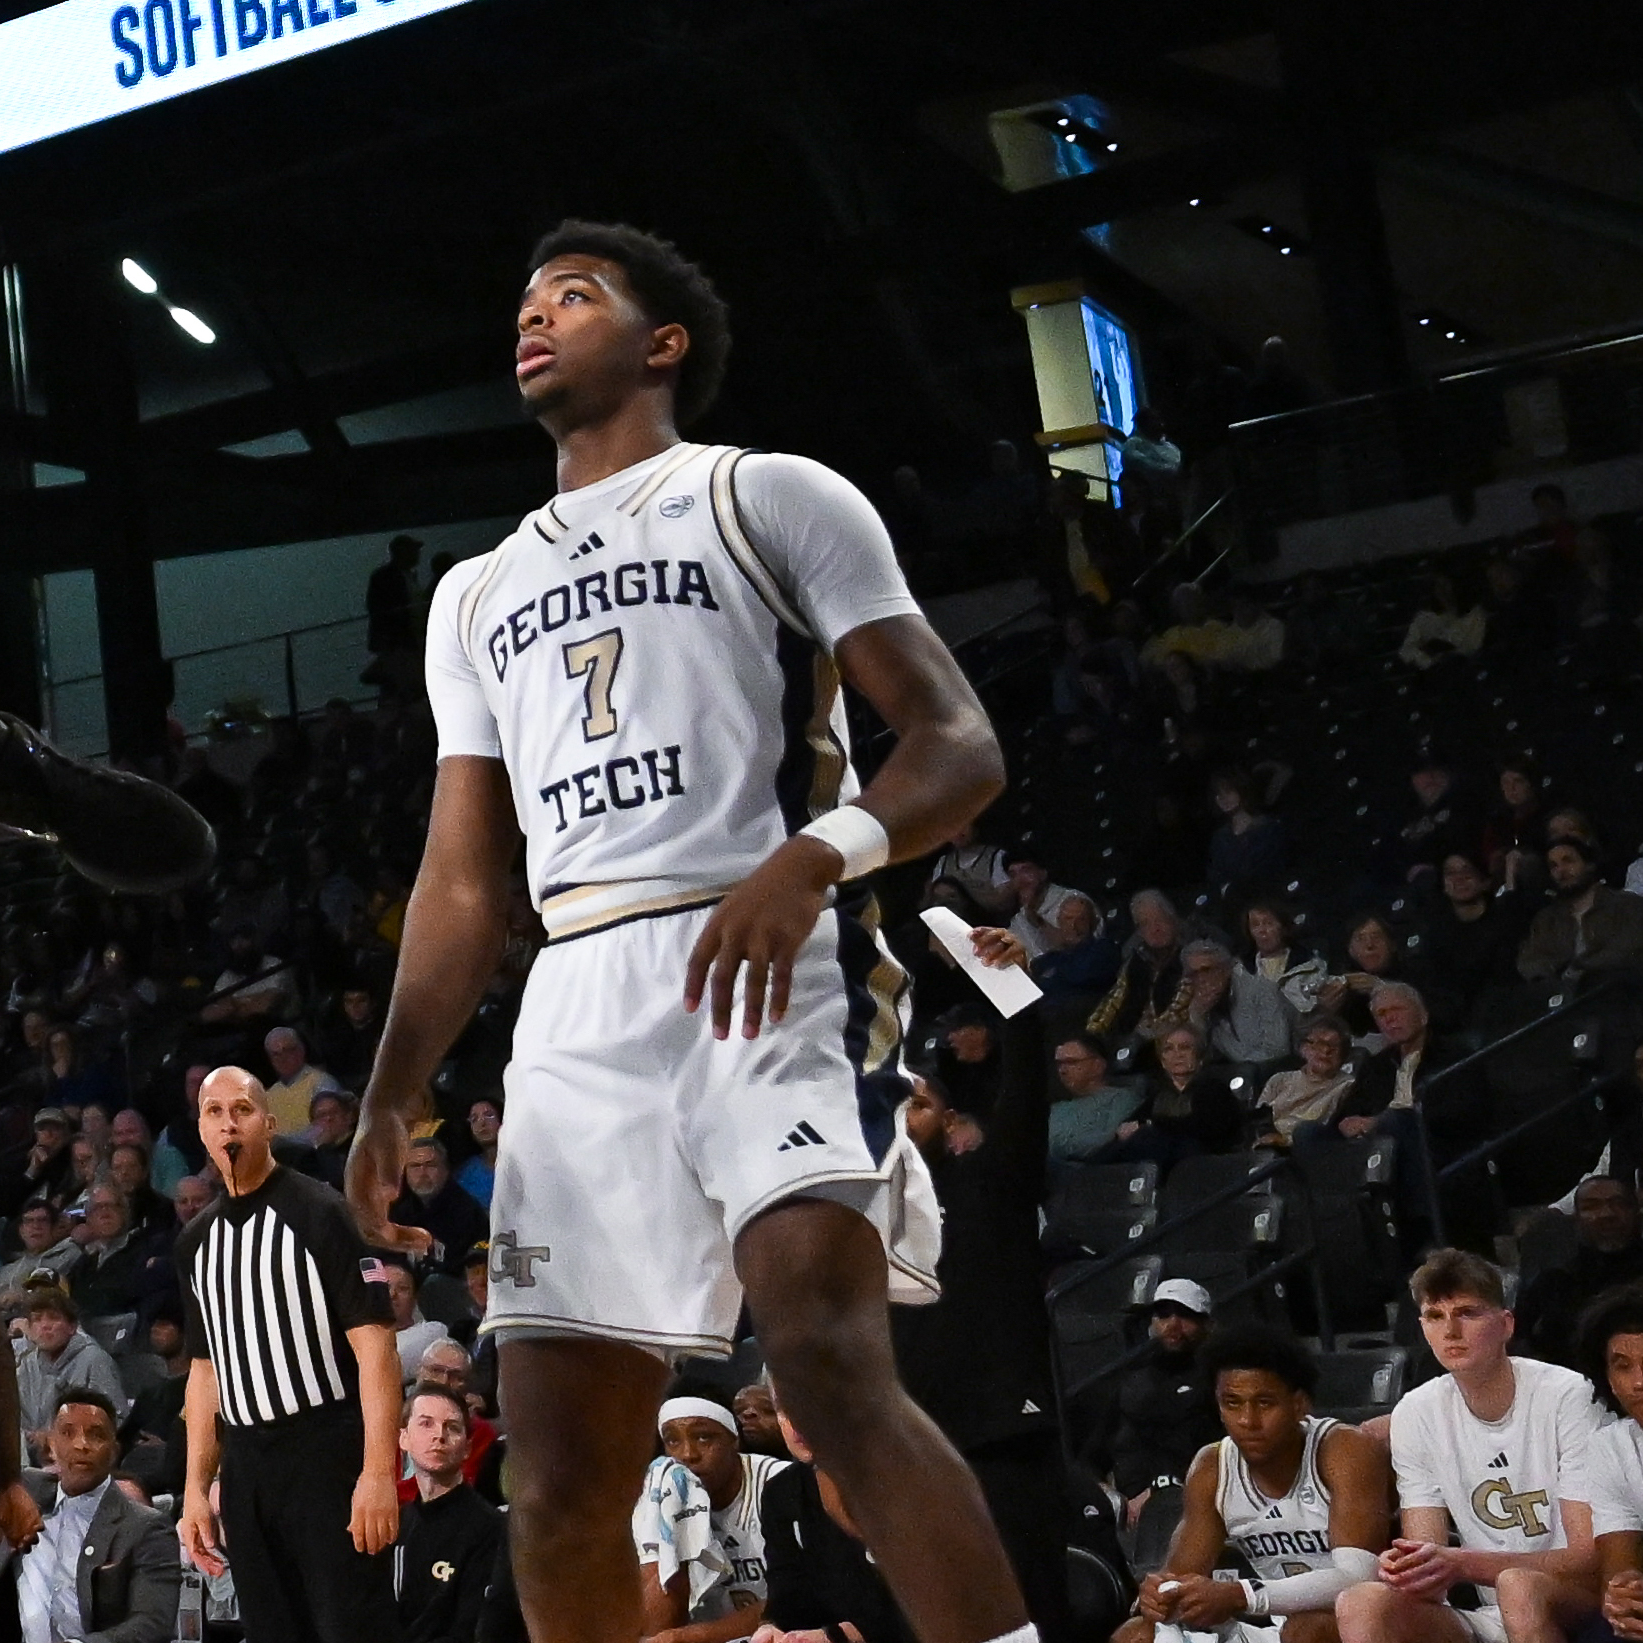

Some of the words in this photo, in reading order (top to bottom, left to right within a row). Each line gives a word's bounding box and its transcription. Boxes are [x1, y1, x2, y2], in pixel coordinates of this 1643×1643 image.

[487, 559, 720, 684] GEORGIA
[561, 627, 625, 744] 7
[539, 744, 686, 835] TECH
[1237, 1529, 1332, 1559] EORGI
[1470, 1476, 1552, 1538] GT
